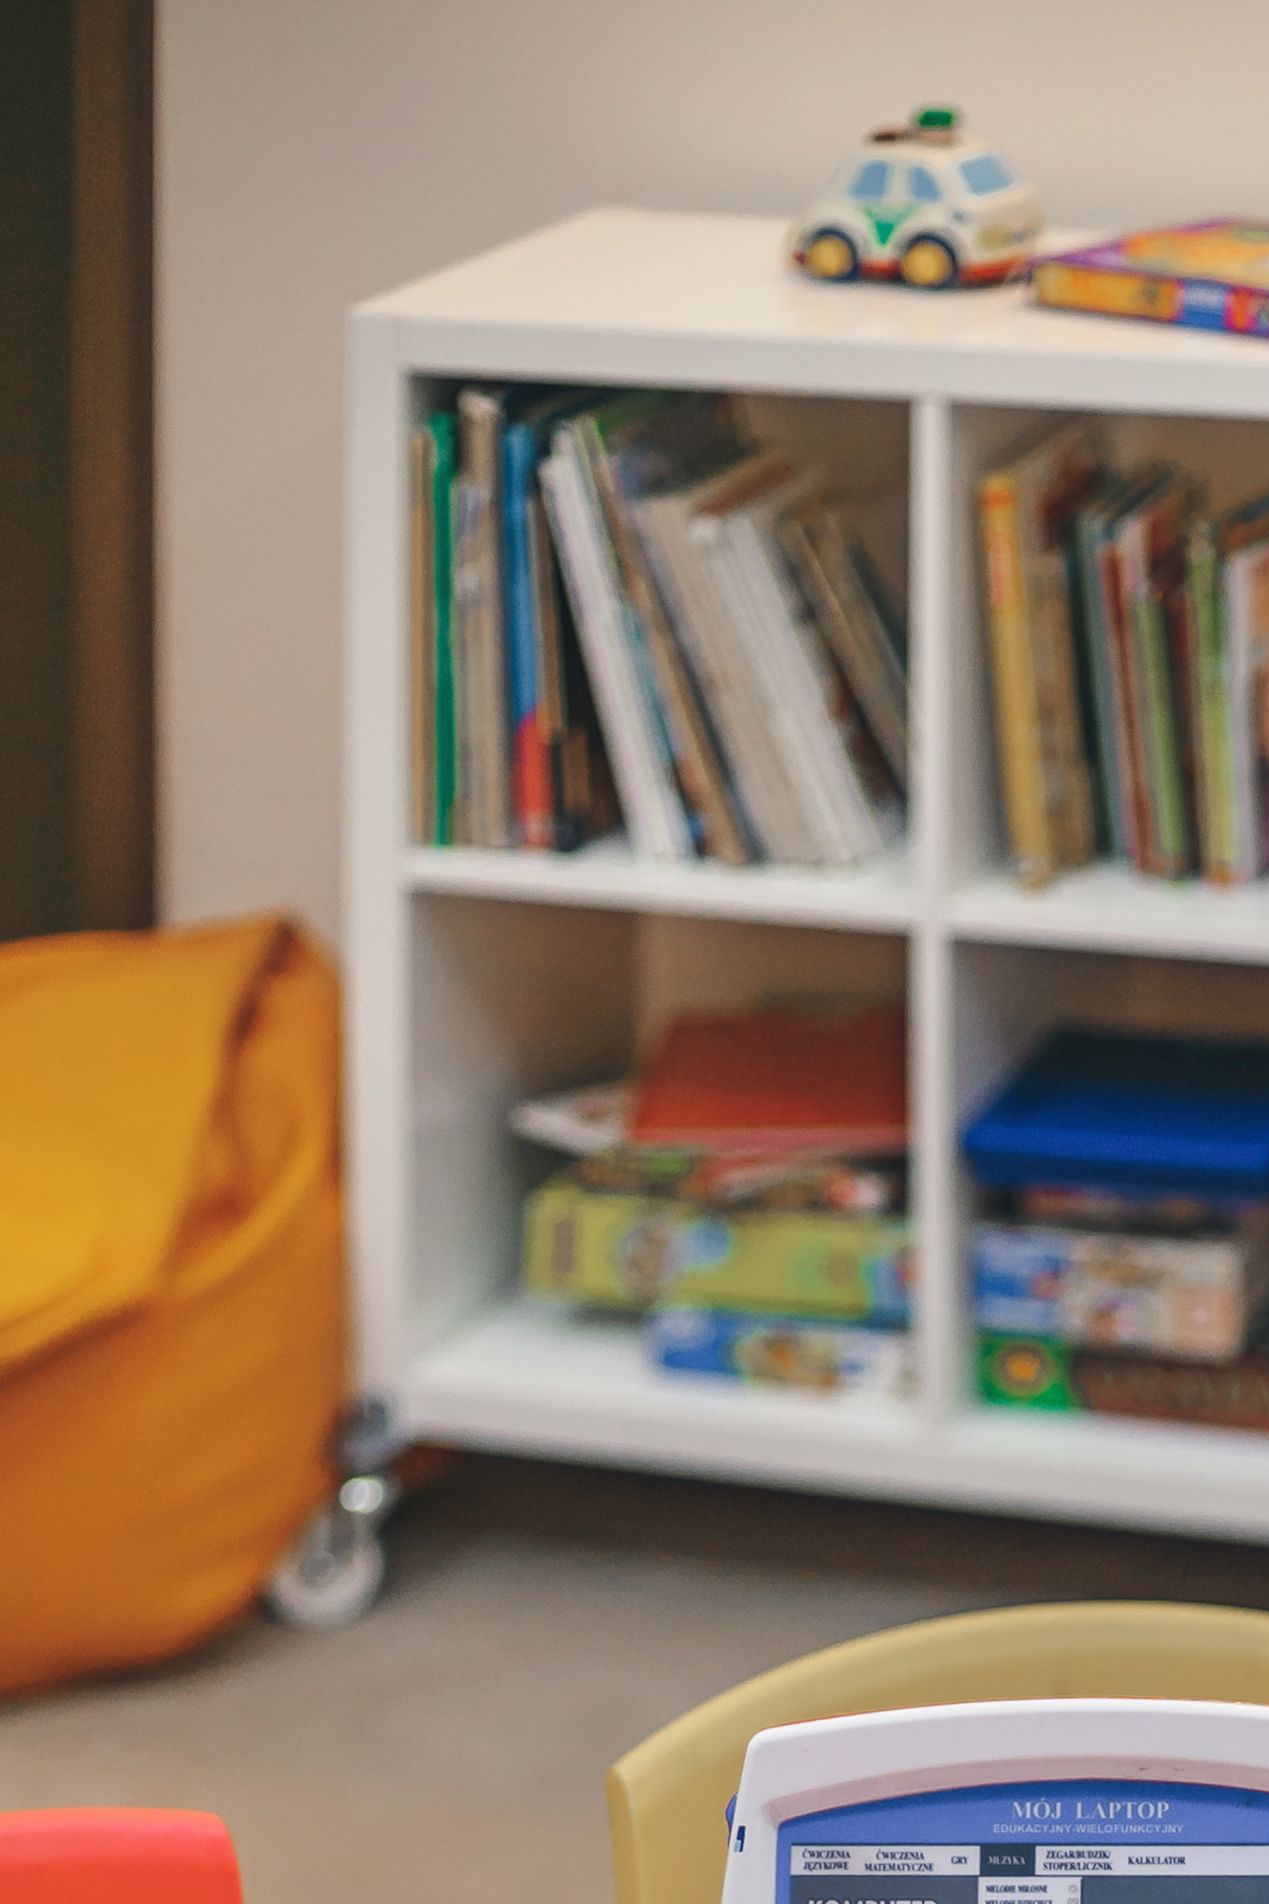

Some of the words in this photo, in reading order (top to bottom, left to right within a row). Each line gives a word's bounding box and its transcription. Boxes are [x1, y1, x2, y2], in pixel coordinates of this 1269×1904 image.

[1012, 1797, 1062, 1819] MÓJ
[1076, 1802, 1170, 1819] LAPTOP
[993, 1824, 1184, 1834] EDUKACYJNY-WIELOFUNKCYJNY
[802, 1848, 851, 1859] ĆWICZENIA
[876, 1849, 925, 1861] ĆWICZENIA
[951, 1856, 968, 1865] GRY
[988, 1855, 1026, 1865] MUZYKA
[1128, 1856, 1186, 1866] KALKULATOR
[803, 1861, 848, 1872] JĘZYKOWE
[864, 1863, 934, 1872] MATEMATYCZNE
